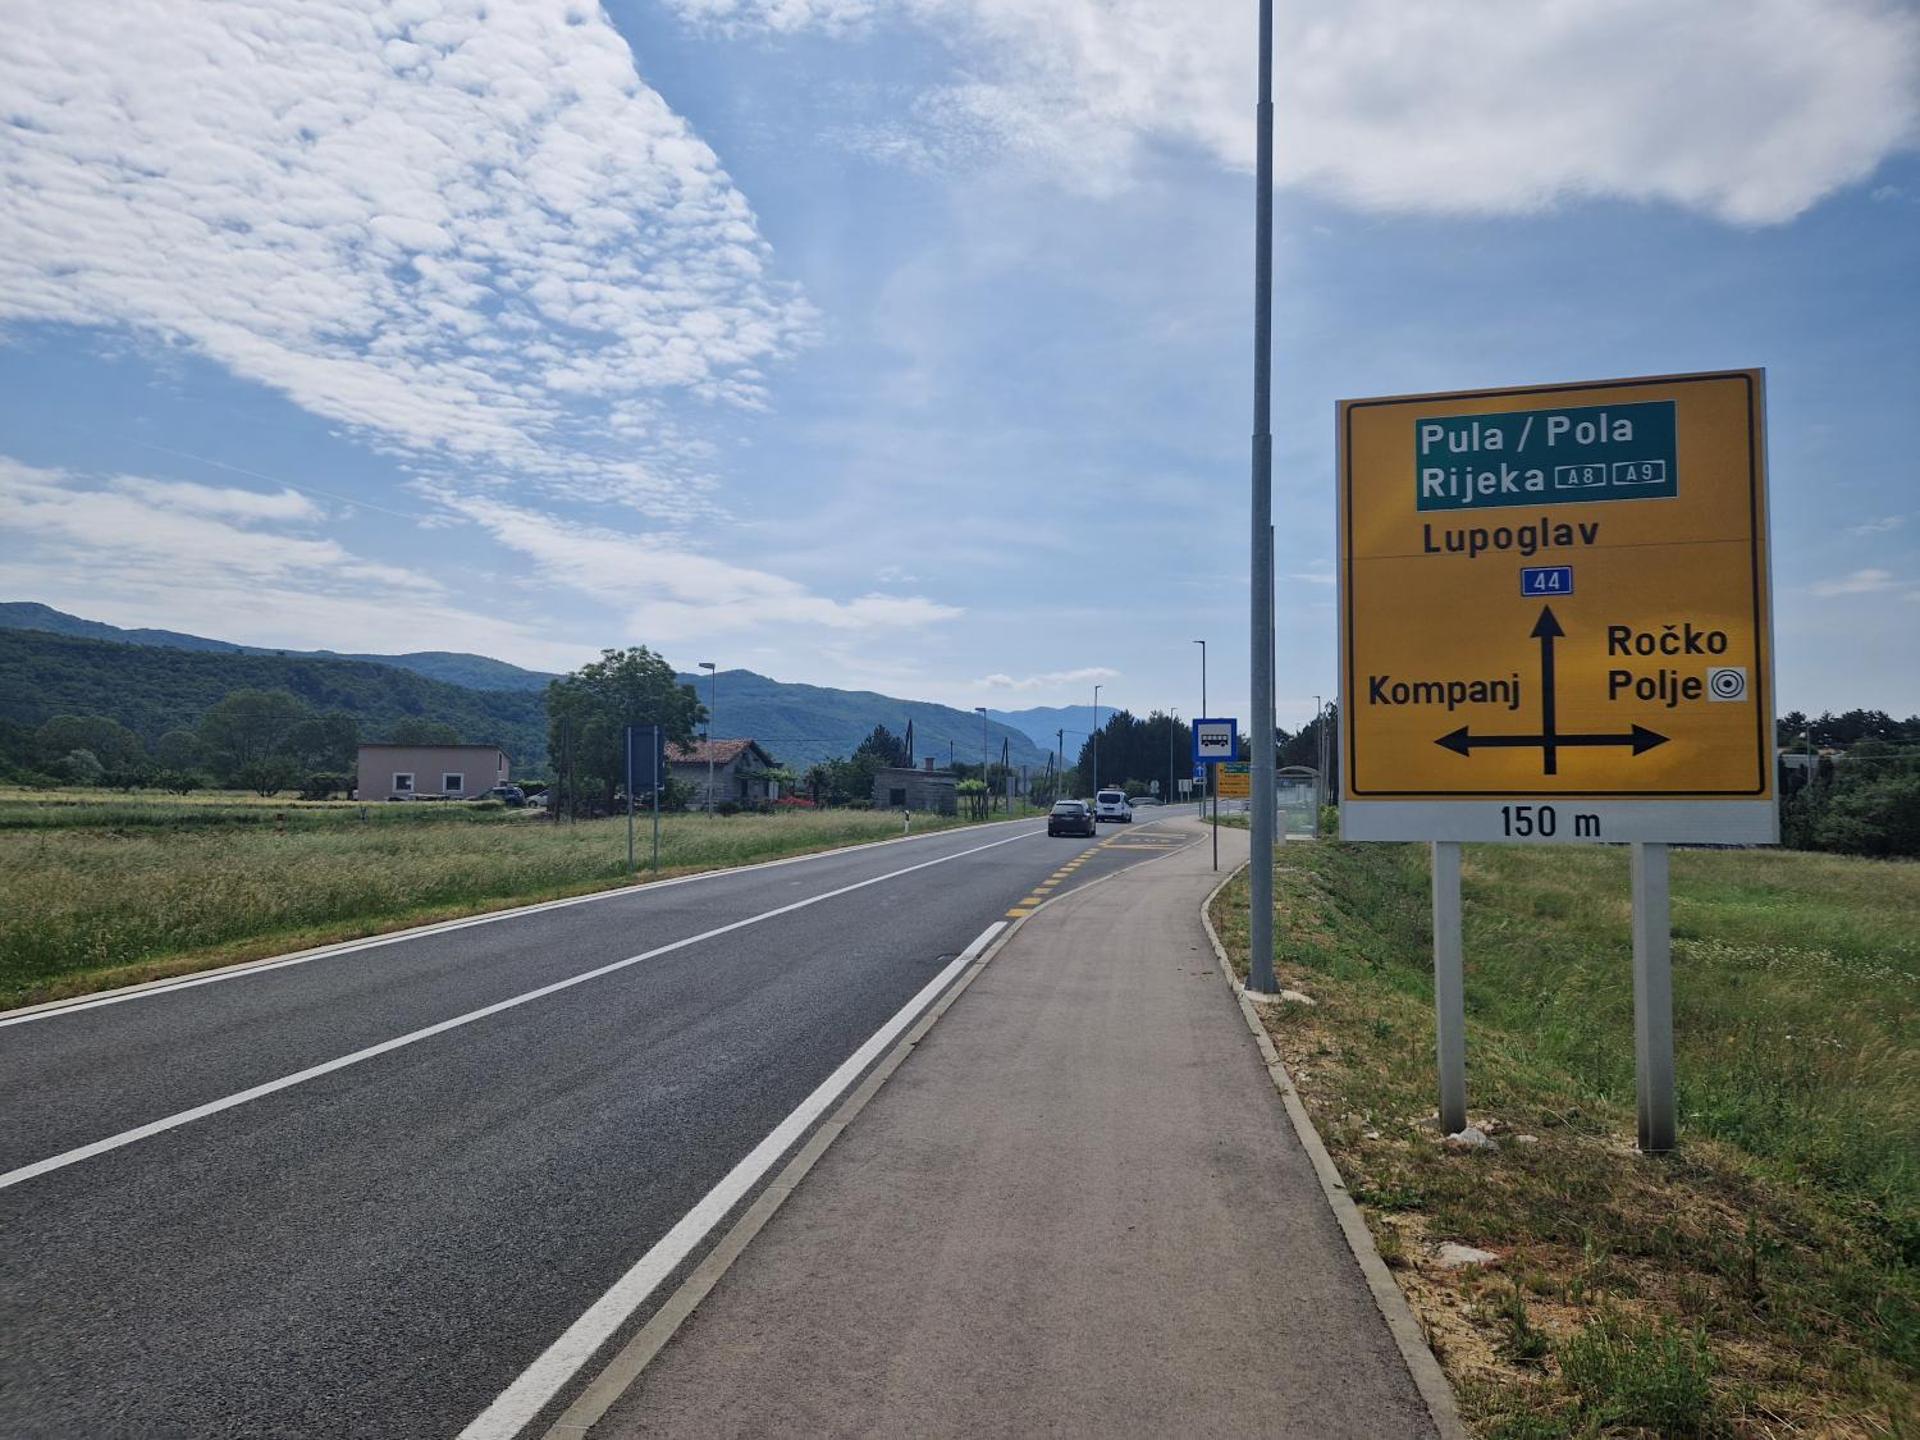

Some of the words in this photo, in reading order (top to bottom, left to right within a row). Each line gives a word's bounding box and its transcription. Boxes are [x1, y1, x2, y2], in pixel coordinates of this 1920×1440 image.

[1421, 421, 1504, 455] Pula
[1516, 416, 1534, 453] /
[1547, 413, 1633, 447] Pola
[1422, 462, 1545, 503] Rijeka
[1567, 467, 1594, 485] A8
[1626, 465, 1653, 481] A9
[1424, 517, 1599, 558] Lupoglav
[1533, 572, 1560, 590] 44
[1607, 623, 1728, 656] Ročko
[1368, 673, 1520, 711] Kompanj
[1608, 669, 1703, 708] Polje
[1501, 806, 1557, 837] 150
[1575, 812, 1601, 837] m
